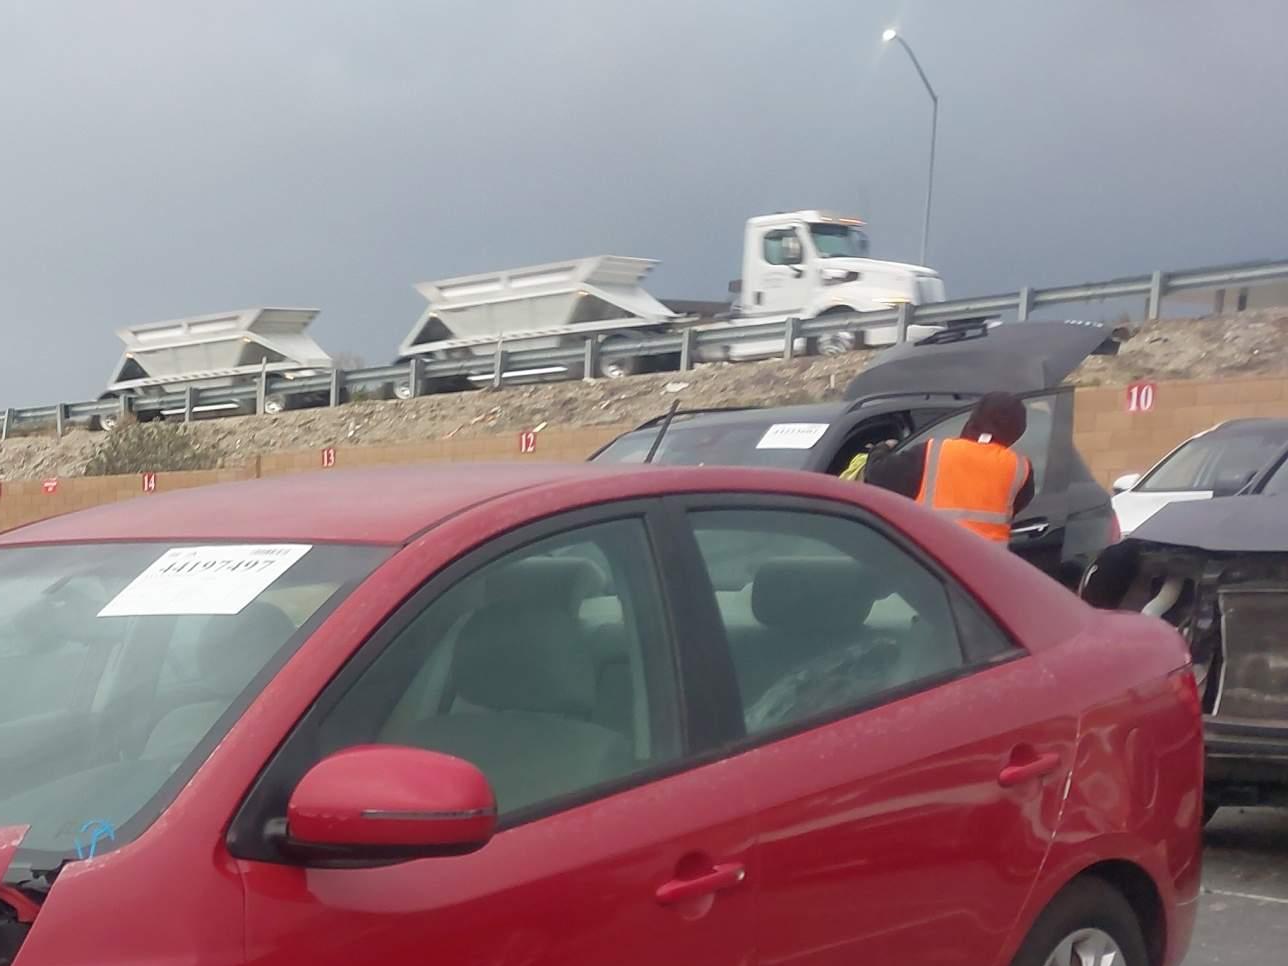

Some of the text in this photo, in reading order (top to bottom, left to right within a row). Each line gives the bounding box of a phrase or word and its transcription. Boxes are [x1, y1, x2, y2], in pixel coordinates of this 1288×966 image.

[1128, 384, 1153, 412] 10
[521, 432, 535, 453] 12
[323, 448, 335, 467] 13
[143, 473, 155, 491] 14
[159, 560, 276, 574] 44197497
